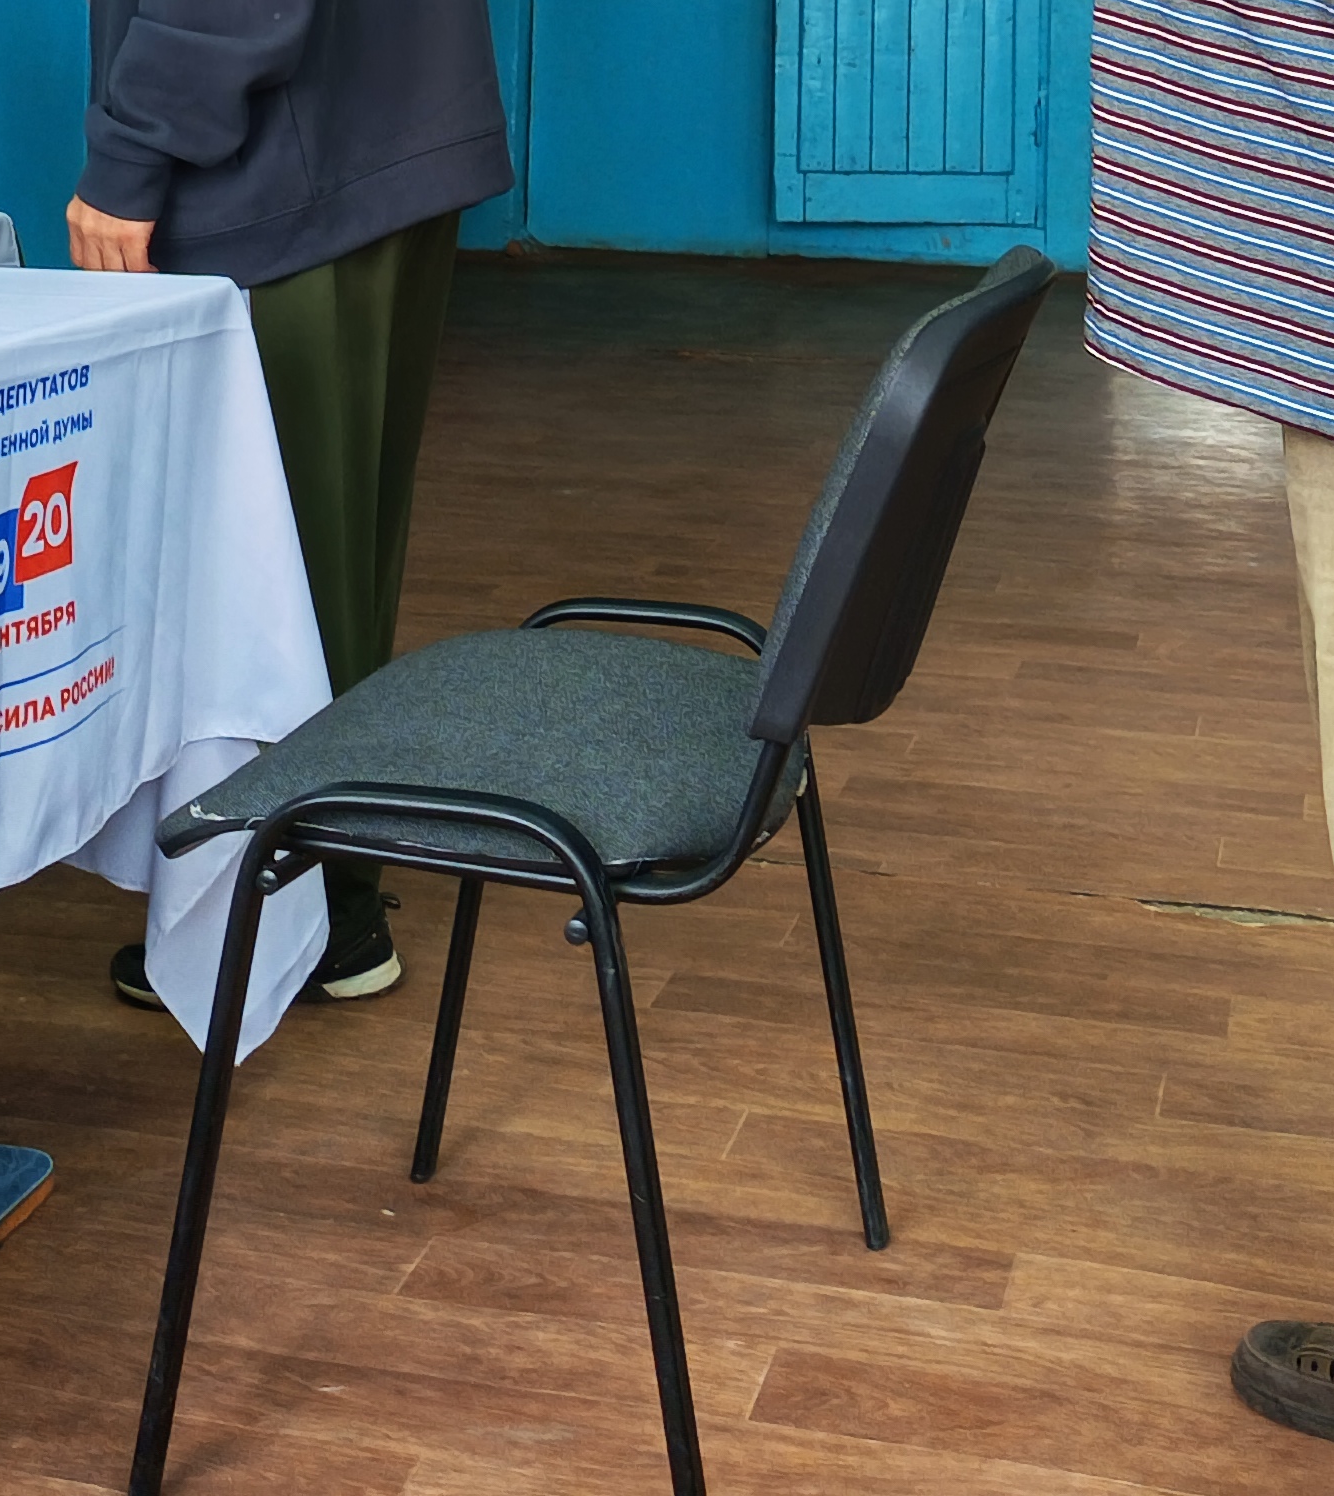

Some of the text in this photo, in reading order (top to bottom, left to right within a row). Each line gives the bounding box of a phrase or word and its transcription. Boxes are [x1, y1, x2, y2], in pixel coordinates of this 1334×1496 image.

[52, 409, 93, 445] ДУМЫ
[22, 490, 68, 558] 20
[60, 656, 116, 712] РОССИИ!
